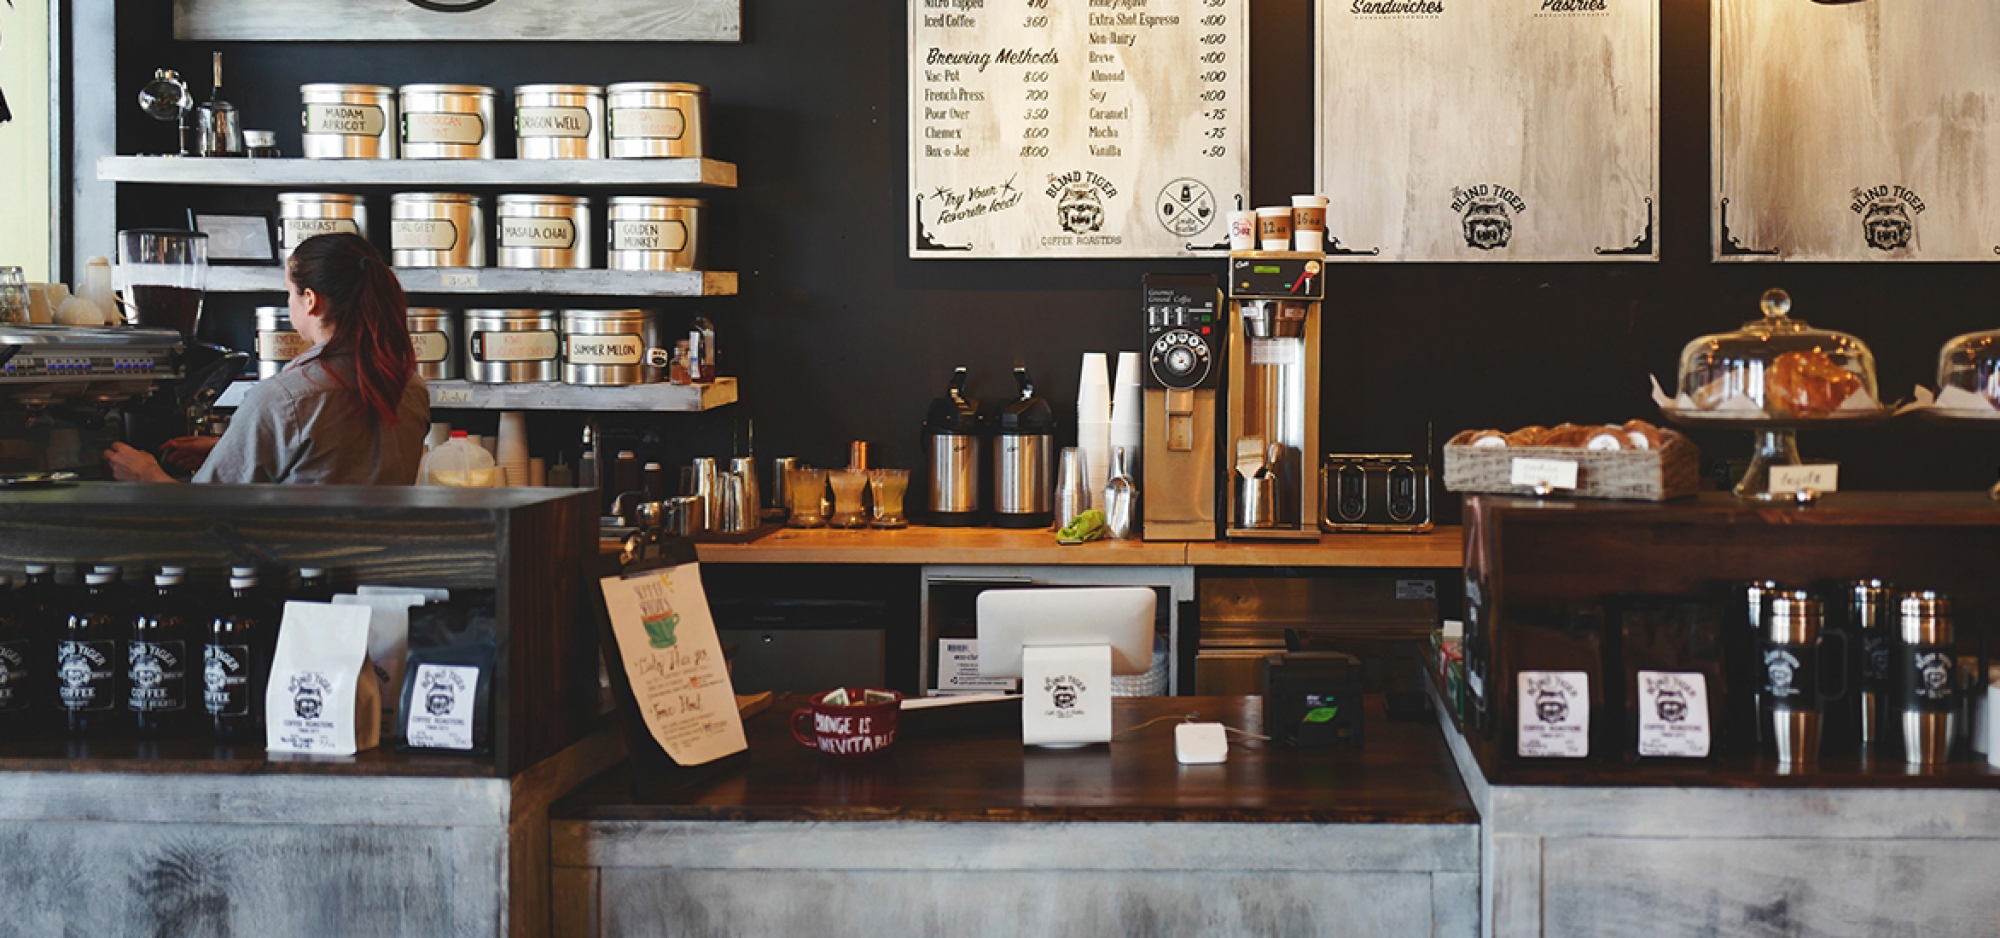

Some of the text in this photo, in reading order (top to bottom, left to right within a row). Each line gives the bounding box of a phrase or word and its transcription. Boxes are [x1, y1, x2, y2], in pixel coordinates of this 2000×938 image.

[925, 14, 976, 28] Iced Coffee
[1089, 12, 1180, 29] Extra Shot Espresso
[926, 47, 1058, 73] Brewing Methods
[925, 88, 985, 101] French Press
[1089, 88, 1107, 103] Soy
[326, 108, 364, 119] MADAM
[925, 107, 970, 120] Pour Over
[1090, 106, 1128, 120] Caramel
[322, 120, 366, 131] APRICOT
[555, 115, 580, 130] WELL
[925, 126, 961, 139] Chemex
[1089, 126, 1118, 139] Mocha
[1089, 144, 1122, 157] Vanilla
[1046, 170, 1118, 199] BLIND TIGER
[944, 192, 965, 211] Try
[1450, 184, 1526, 214] BLIND TIGER
[1850, 184, 1926, 215] BLIND TIGER
[623, 223, 659, 236] GOLDEN
[1077, 235, 1122, 245] ROASTERS
[573, 344, 605, 357] SUMMER
[606, 344, 636, 356] MELON
[60, 687, 96, 698] COFFEE
[131, 687, 167, 698] COFFEE
[858, 717, 873, 734] IS
